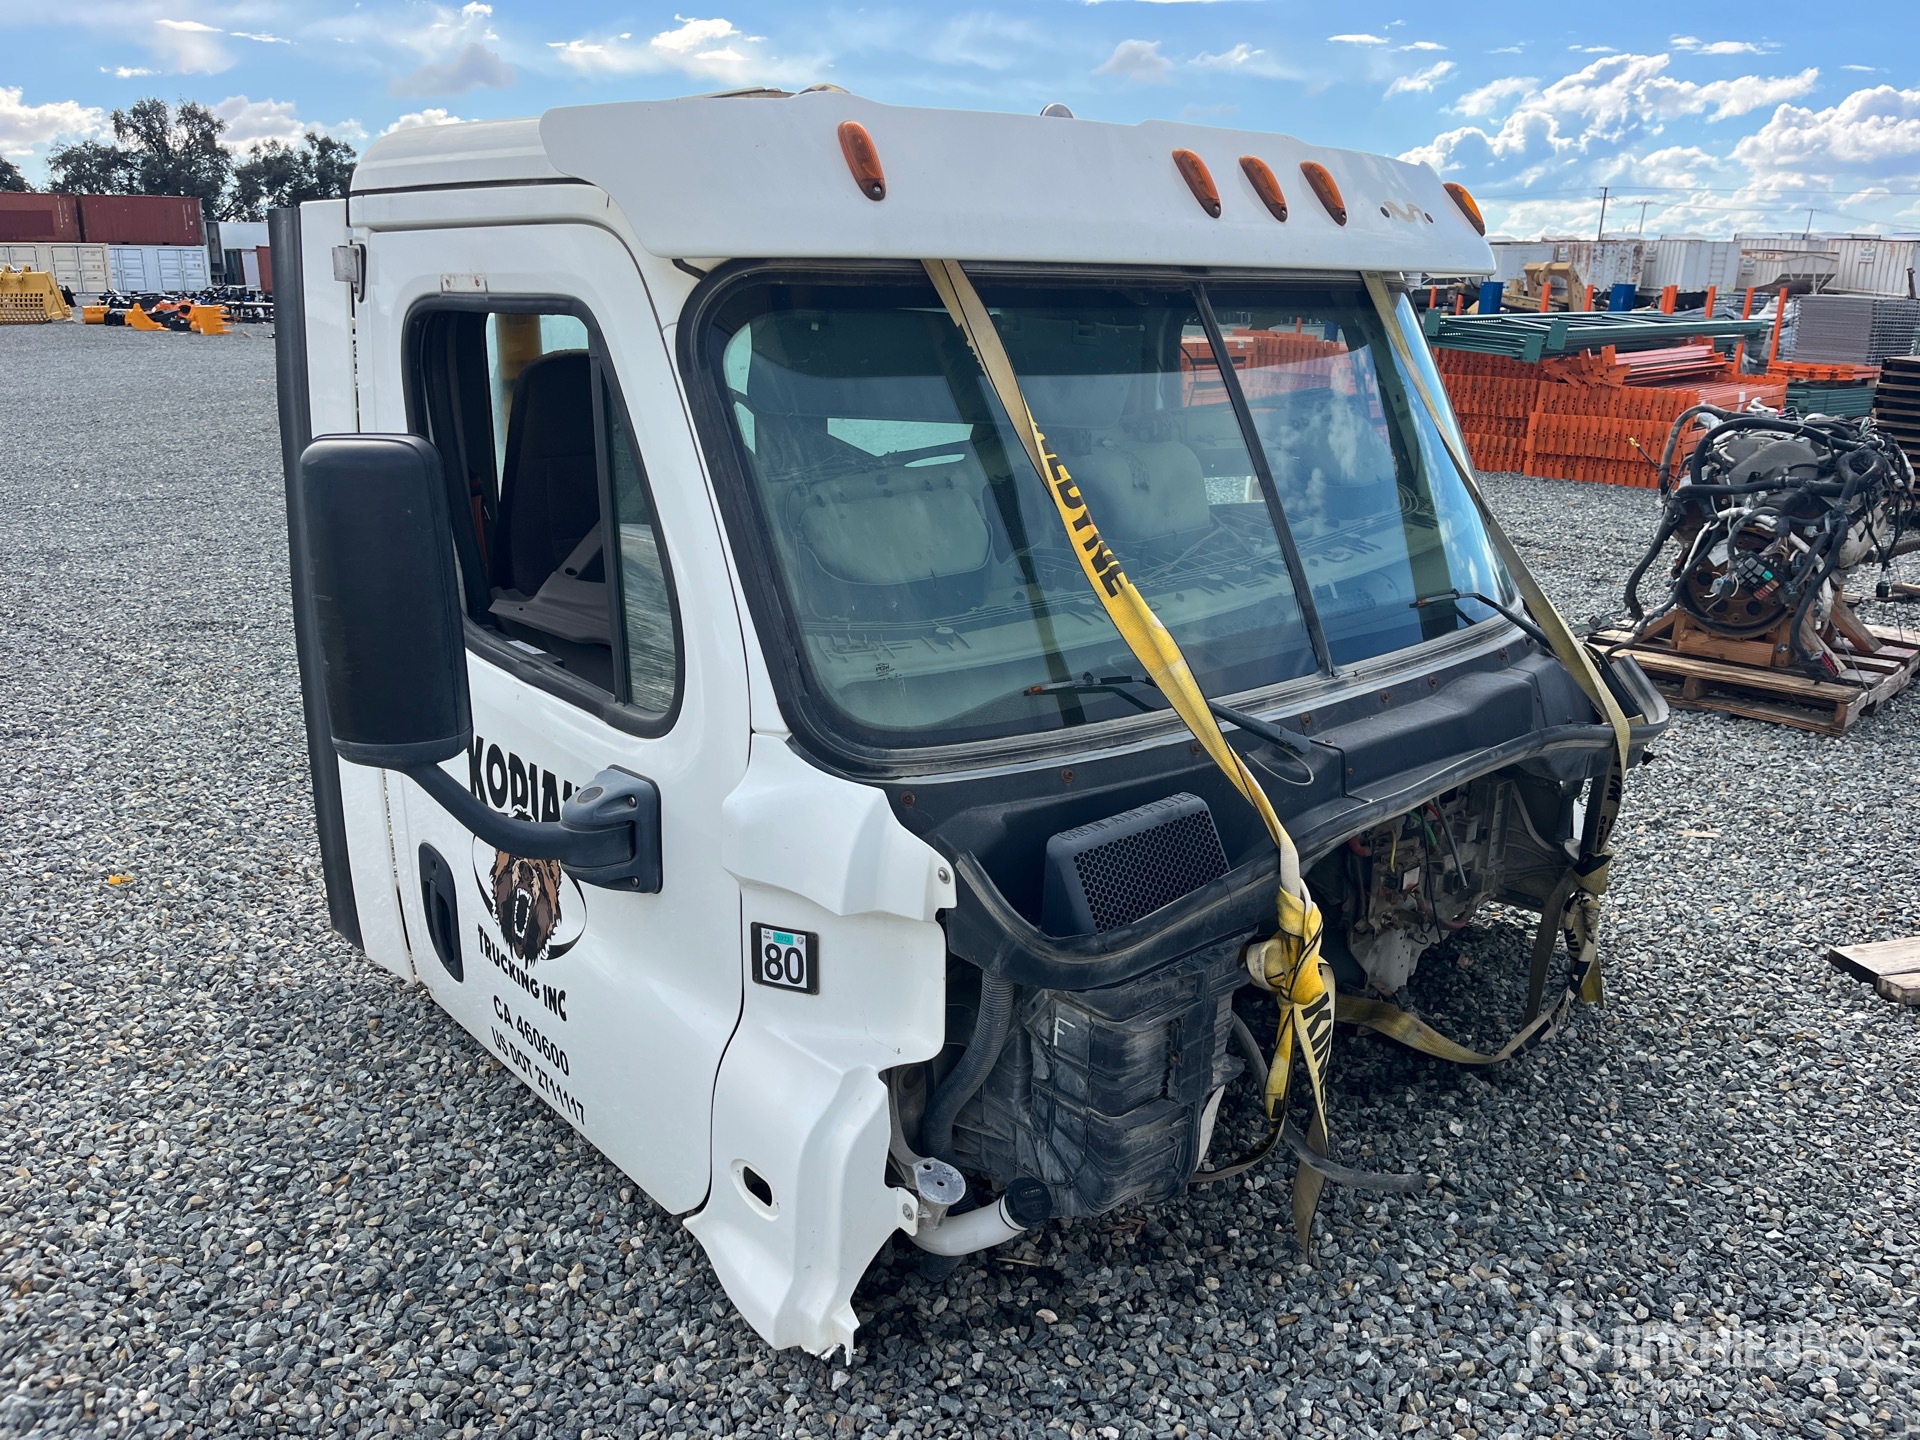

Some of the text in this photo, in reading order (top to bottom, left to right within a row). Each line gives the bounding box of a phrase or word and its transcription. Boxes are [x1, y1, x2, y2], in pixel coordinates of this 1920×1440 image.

[466, 735, 581, 823] KODIA
[477, 923, 567, 1022] TRUCKING INC
[764, 943, 804, 984] 80
[493, 994, 569, 1076] CA 460600
[1053, 1017, 1076, 1046] F
[491, 1026, 585, 1126] US DOT 2711117
